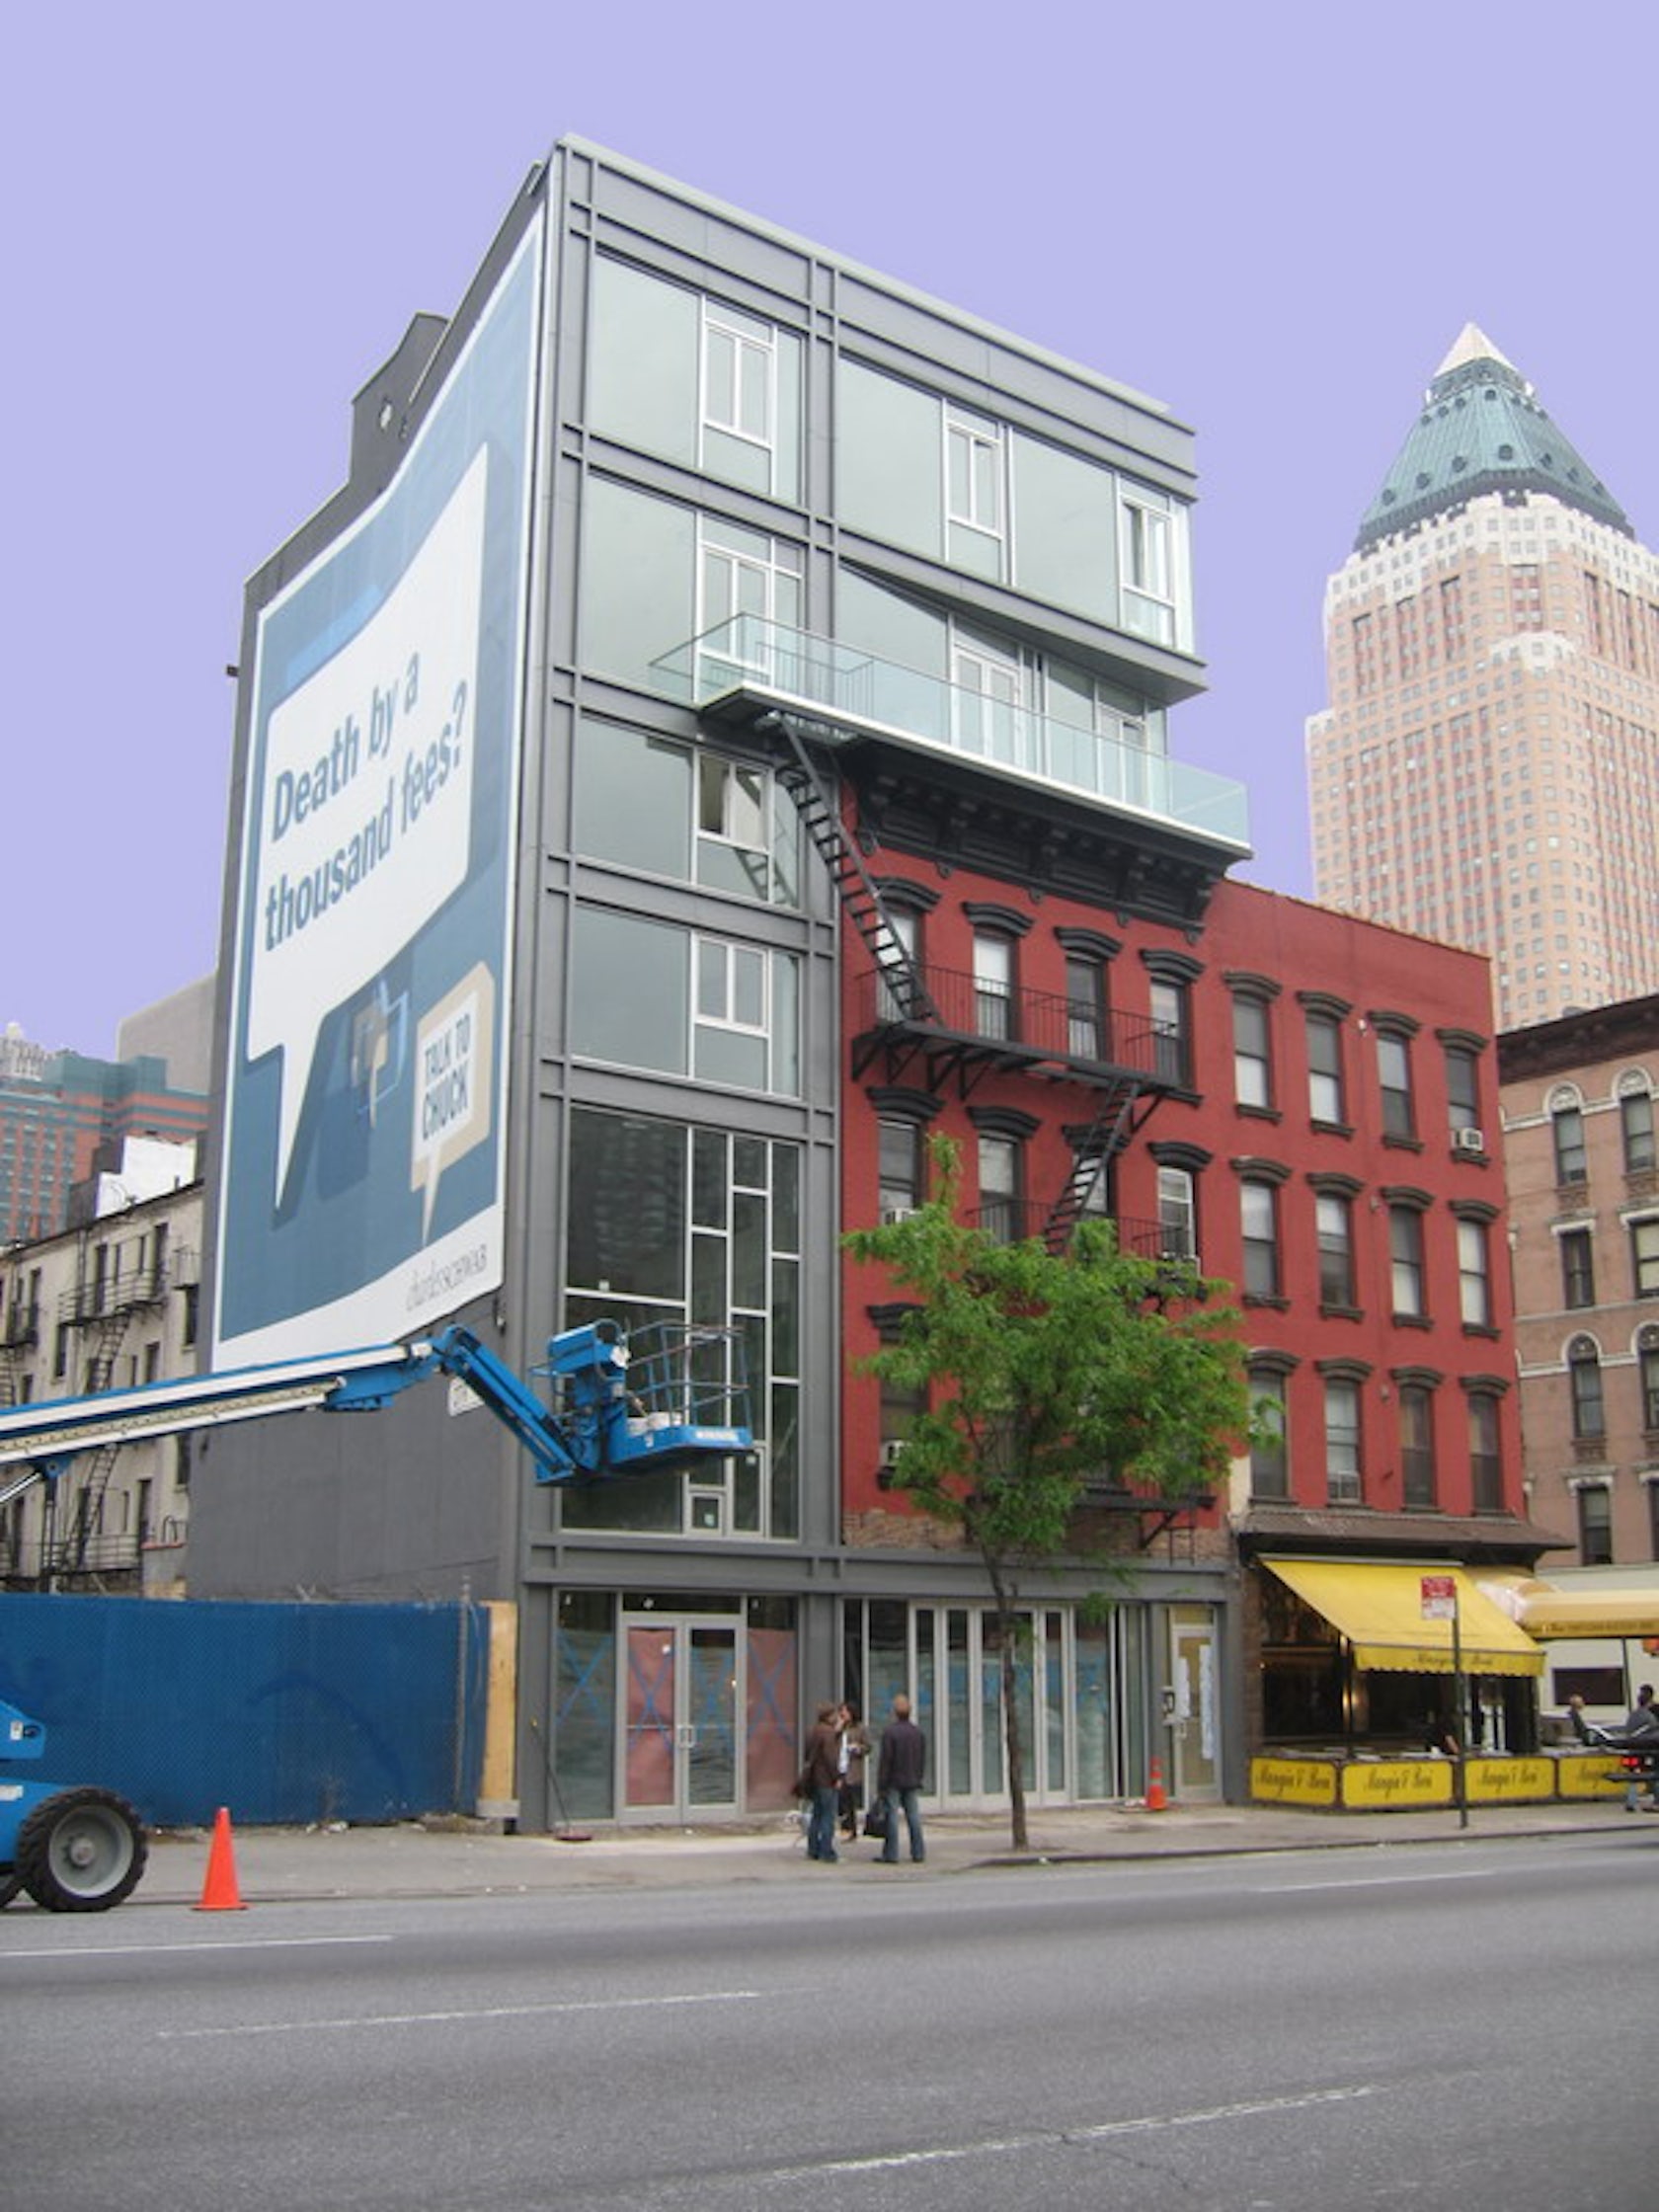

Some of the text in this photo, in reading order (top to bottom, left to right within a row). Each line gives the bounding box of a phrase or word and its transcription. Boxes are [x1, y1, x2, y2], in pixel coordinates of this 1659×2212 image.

[265, 679, 467, 952] thousand fees?
[272, 651, 420, 842] Death by a
